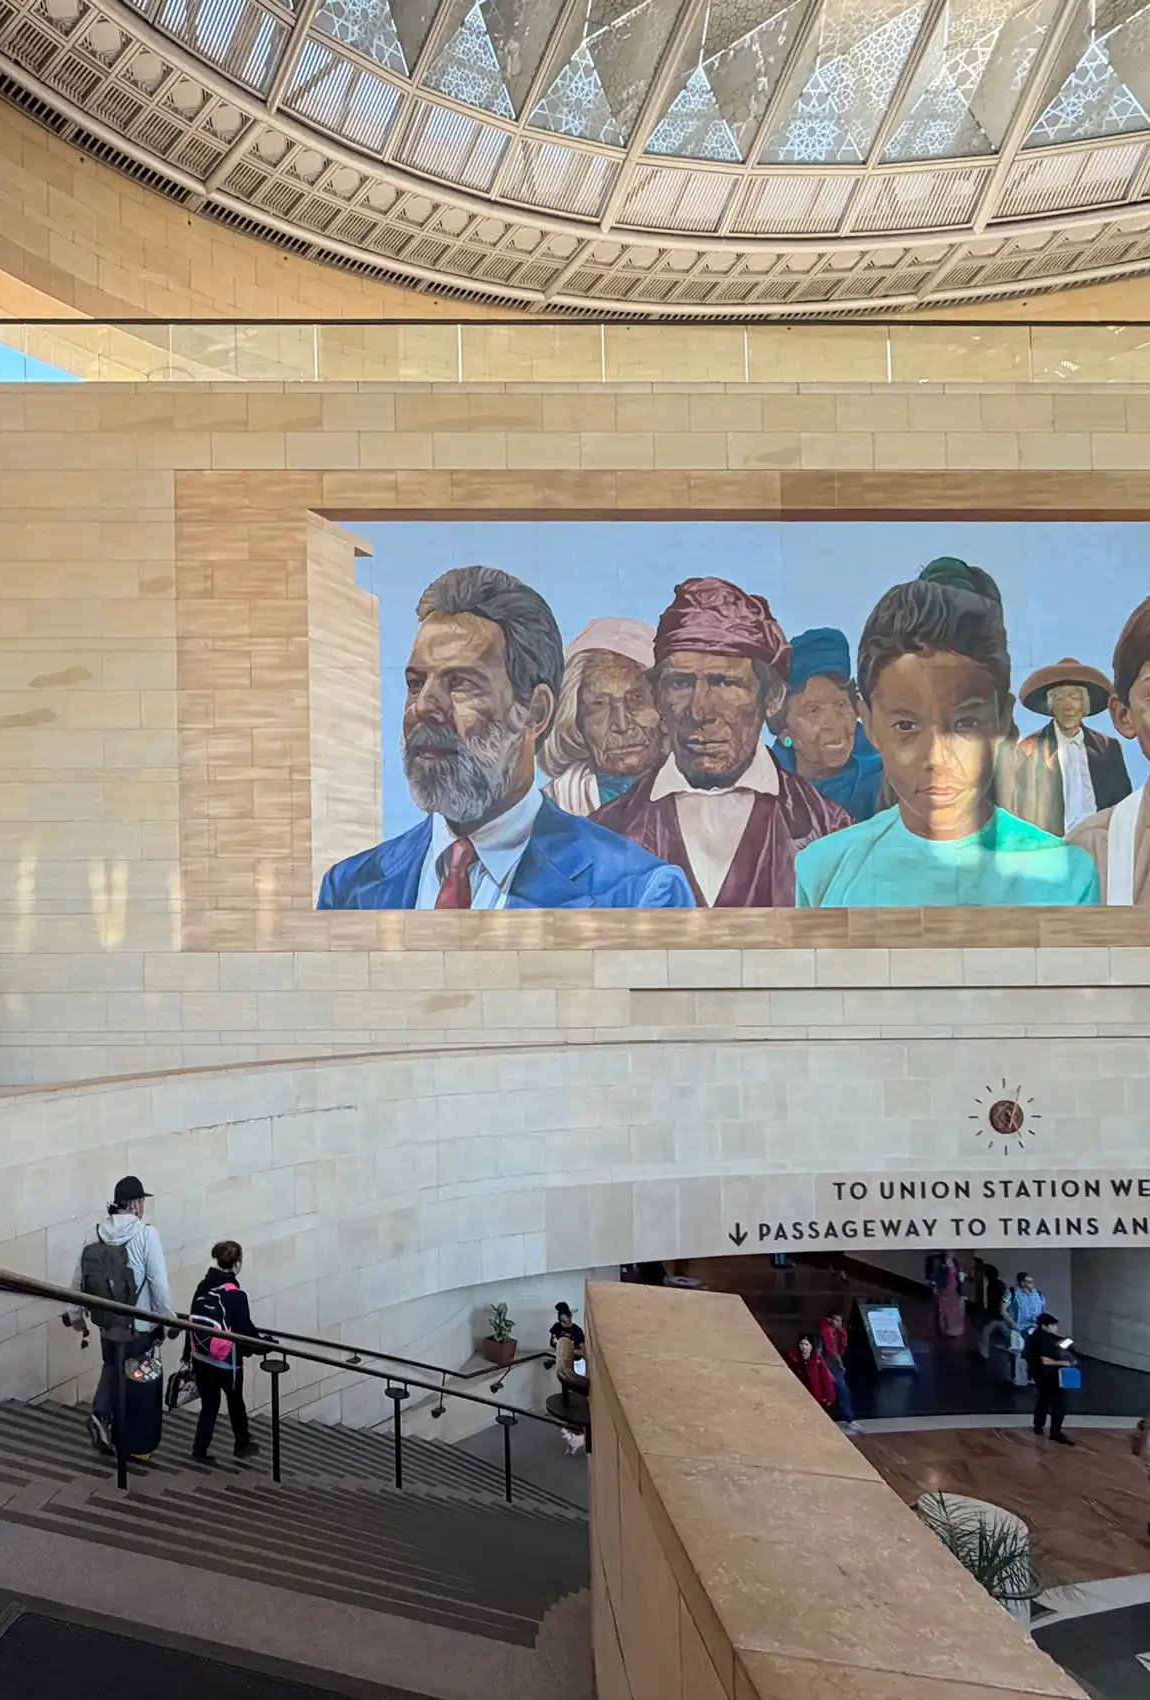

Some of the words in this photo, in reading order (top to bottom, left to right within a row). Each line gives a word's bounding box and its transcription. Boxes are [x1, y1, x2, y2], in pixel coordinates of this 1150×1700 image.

[833, 1181, 868, 1201] TO
[879, 1179, 971, 1200] UNION
[983, 1178, 1102, 1199] STATION
[1110, 1178, 1150, 1198] WE
[758, 1218, 938, 1242] PASSAGEWAY
[951, 1218, 987, 1237] TO
[998, 1217, 1100, 1236] TRAINS
[1112, 1216, 1149, 1236] AN
